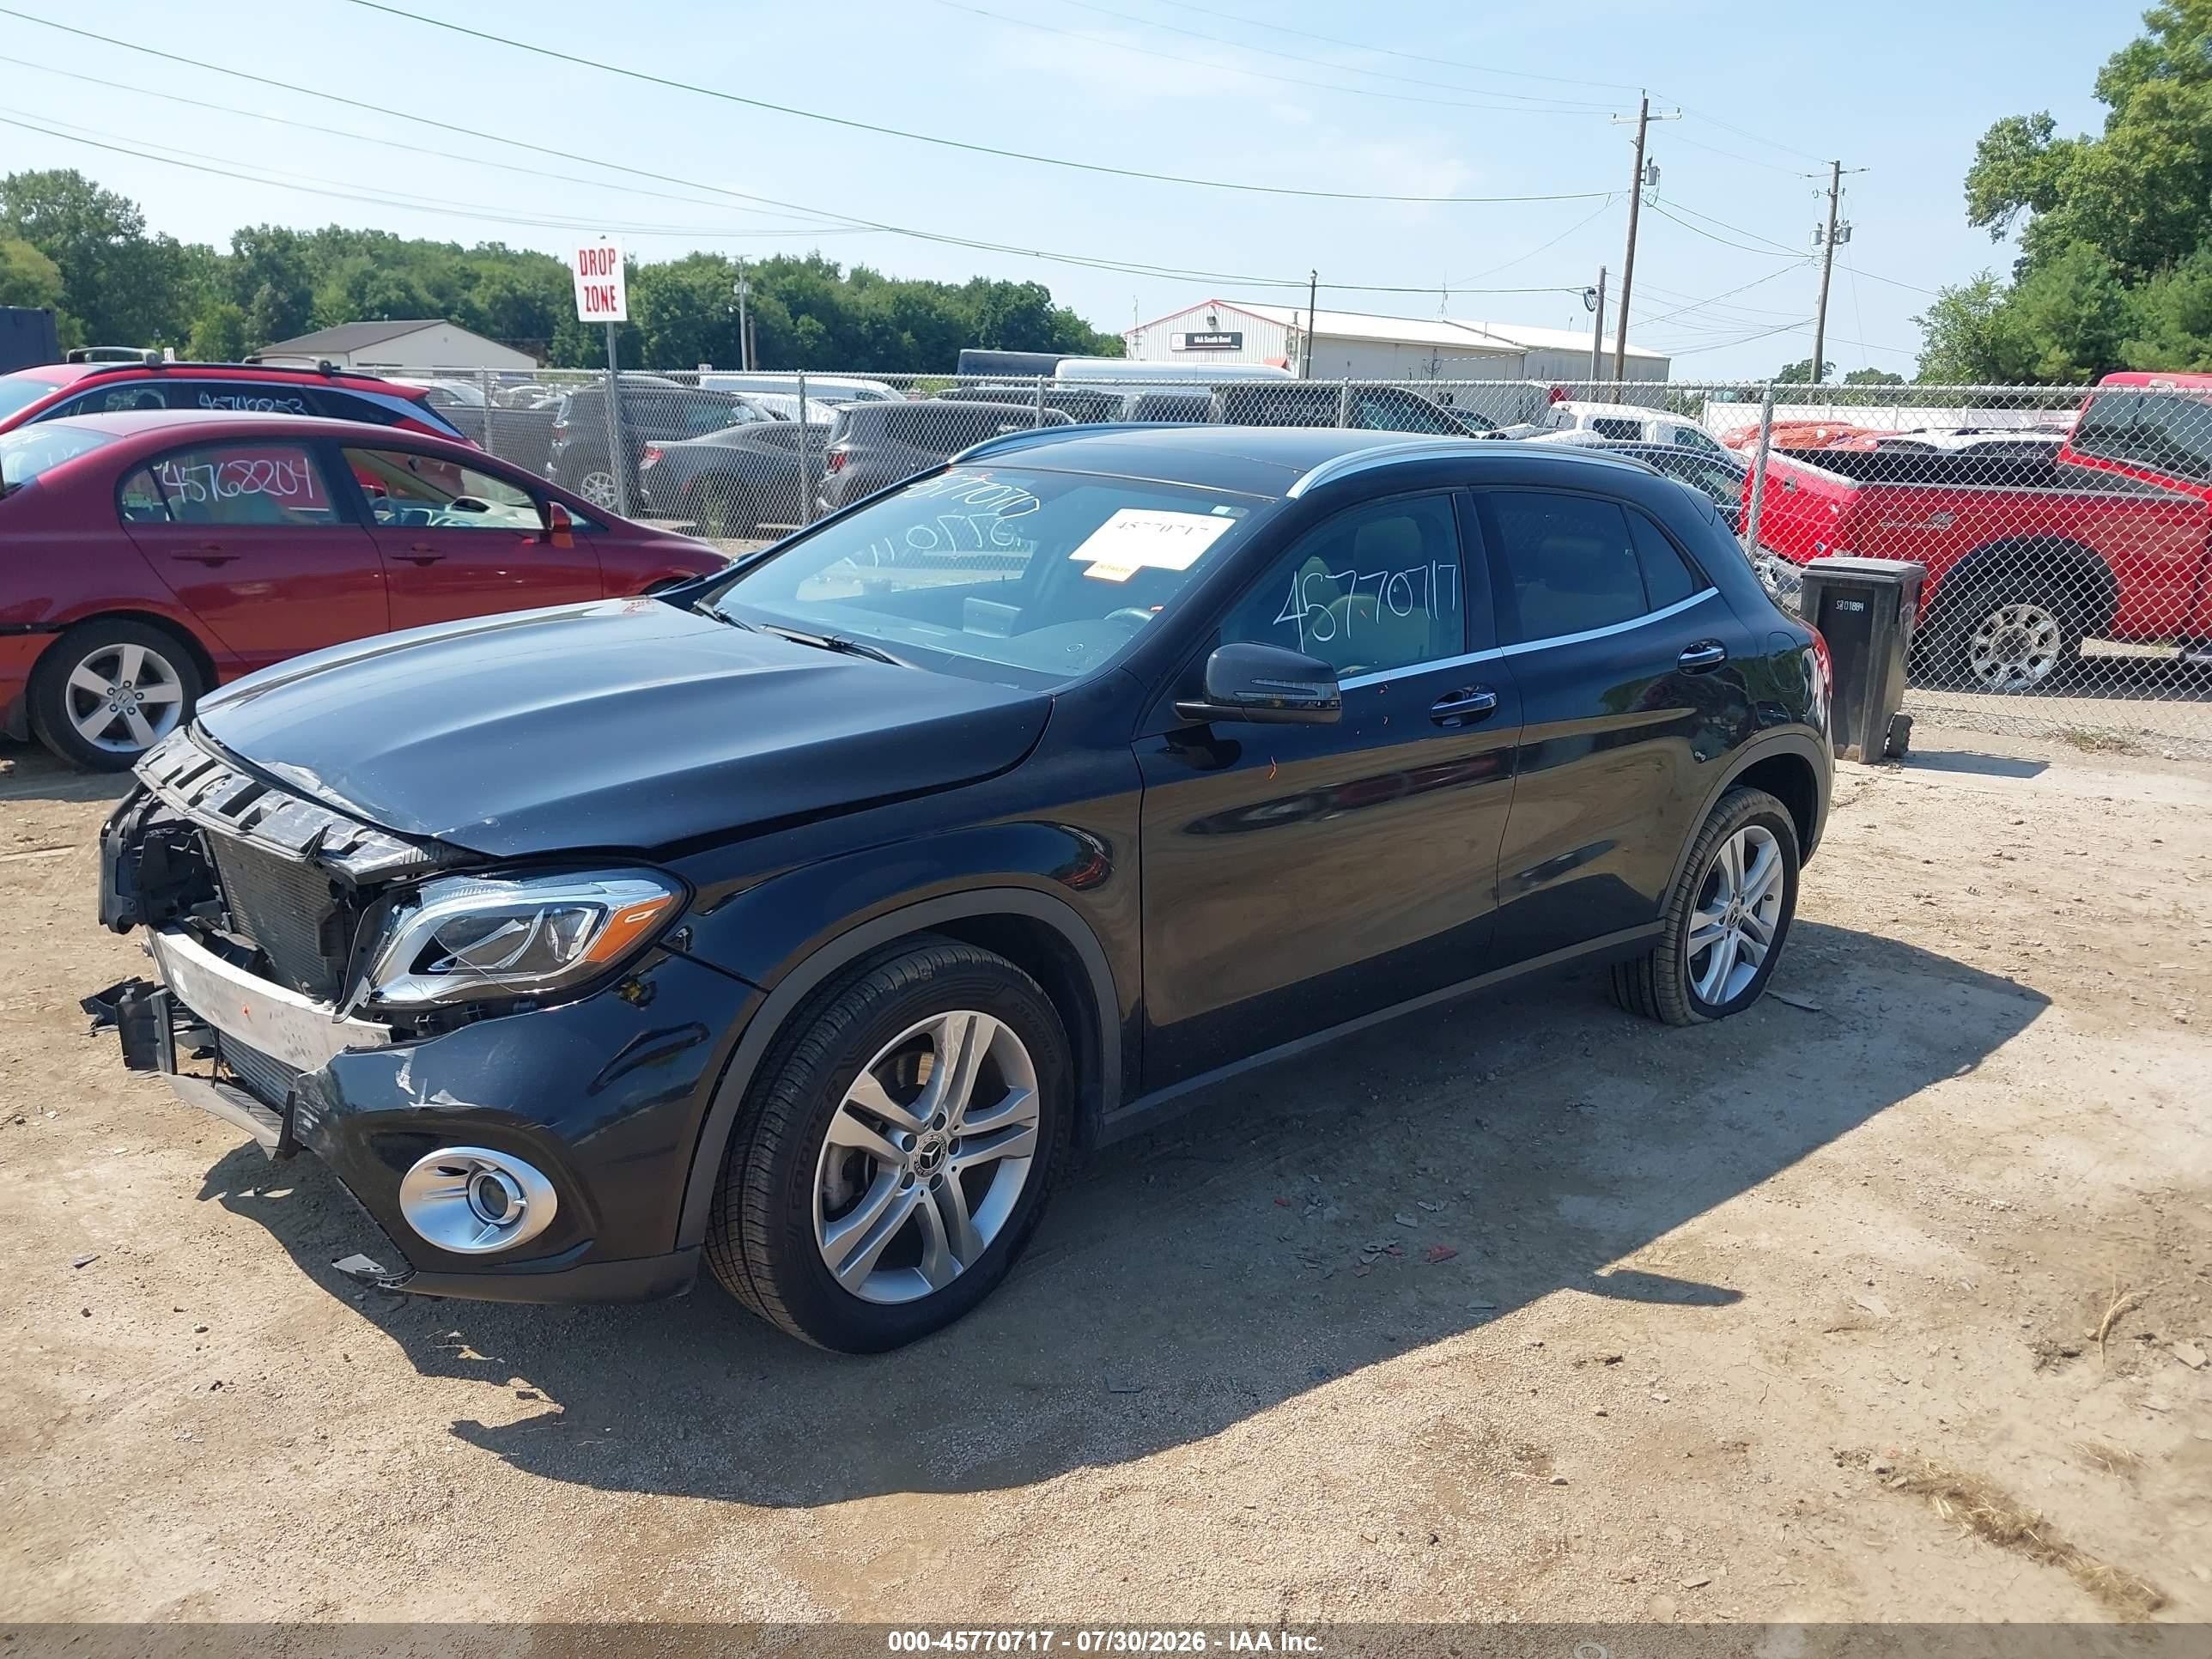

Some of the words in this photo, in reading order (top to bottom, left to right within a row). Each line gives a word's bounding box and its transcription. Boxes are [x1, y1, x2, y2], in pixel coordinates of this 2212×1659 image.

[579, 247, 616, 276] DROP
[584, 284, 617, 313] ZONE
[161, 458, 313, 503] 45768204
[1272, 559, 1457, 653] 45770717
